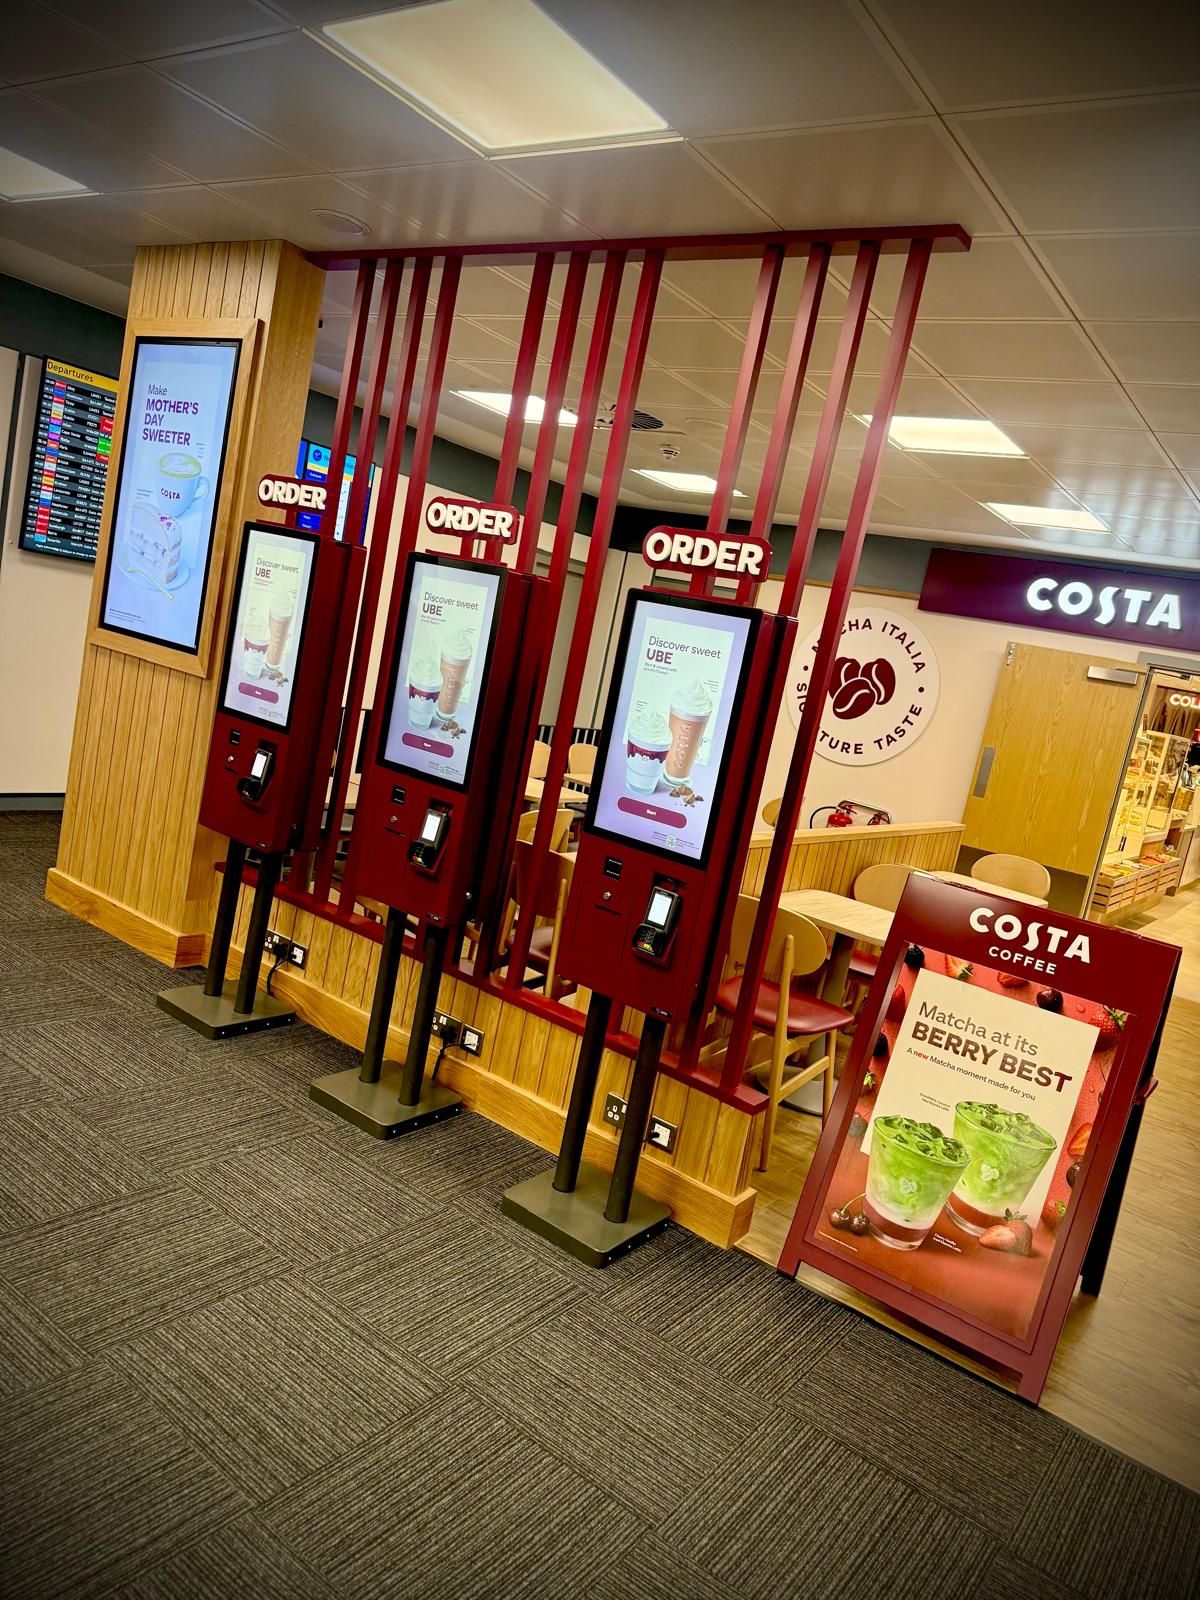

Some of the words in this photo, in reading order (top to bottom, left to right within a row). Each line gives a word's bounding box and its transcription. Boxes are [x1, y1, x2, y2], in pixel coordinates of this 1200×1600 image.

[47, 361, 95, 383] Departures
[148, 384, 168, 398] Make
[145, 398, 200, 416] MOTHER'S
[144, 412, 166, 428] DAY
[141, 427, 191, 446] SWEETER
[160, 488, 181, 500] COSTA
[259, 478, 327, 511] ORDER
[427, 500, 514, 539] ORDER
[256, 556, 281, 570] Discover
[281, 563, 300, 576] sweet
[645, 531, 765, 576] ORDER
[255, 566, 272, 579] UBE
[422, 602, 443, 617] UBE
[423, 591, 455, 606] Discover
[455, 599, 480, 613] sweet
[1026, 577, 1182, 631] COSTA
[646, 648, 673, 665] UBE
[649, 635, 690, 653] Discover
[691, 645, 722, 660] sweet
[882, 621, 926, 674] ITALIA
[873, 708, 923, 751] TASTE
[969, 906, 1091, 964] COSTA
[988, 945, 1058, 976] COFFEE
[918, 1000, 987, 1039] Matcha
[991, 1029, 1011, 1047] at
[1017, 1034, 1039, 1057] its
[910, 1020, 999, 1066] BERRY
[999, 1051, 1073, 1094] BEST
[905, 1047, 914, 1055] A
[913, 1050, 930, 1061] new
[929, 1055, 957, 1073] Matcha
[956, 1064, 988, 1082] moment
[988, 1073, 1009, 1089] made
[1008, 1079, 1022, 1093] for
[1020, 1086, 1037, 1102] you
